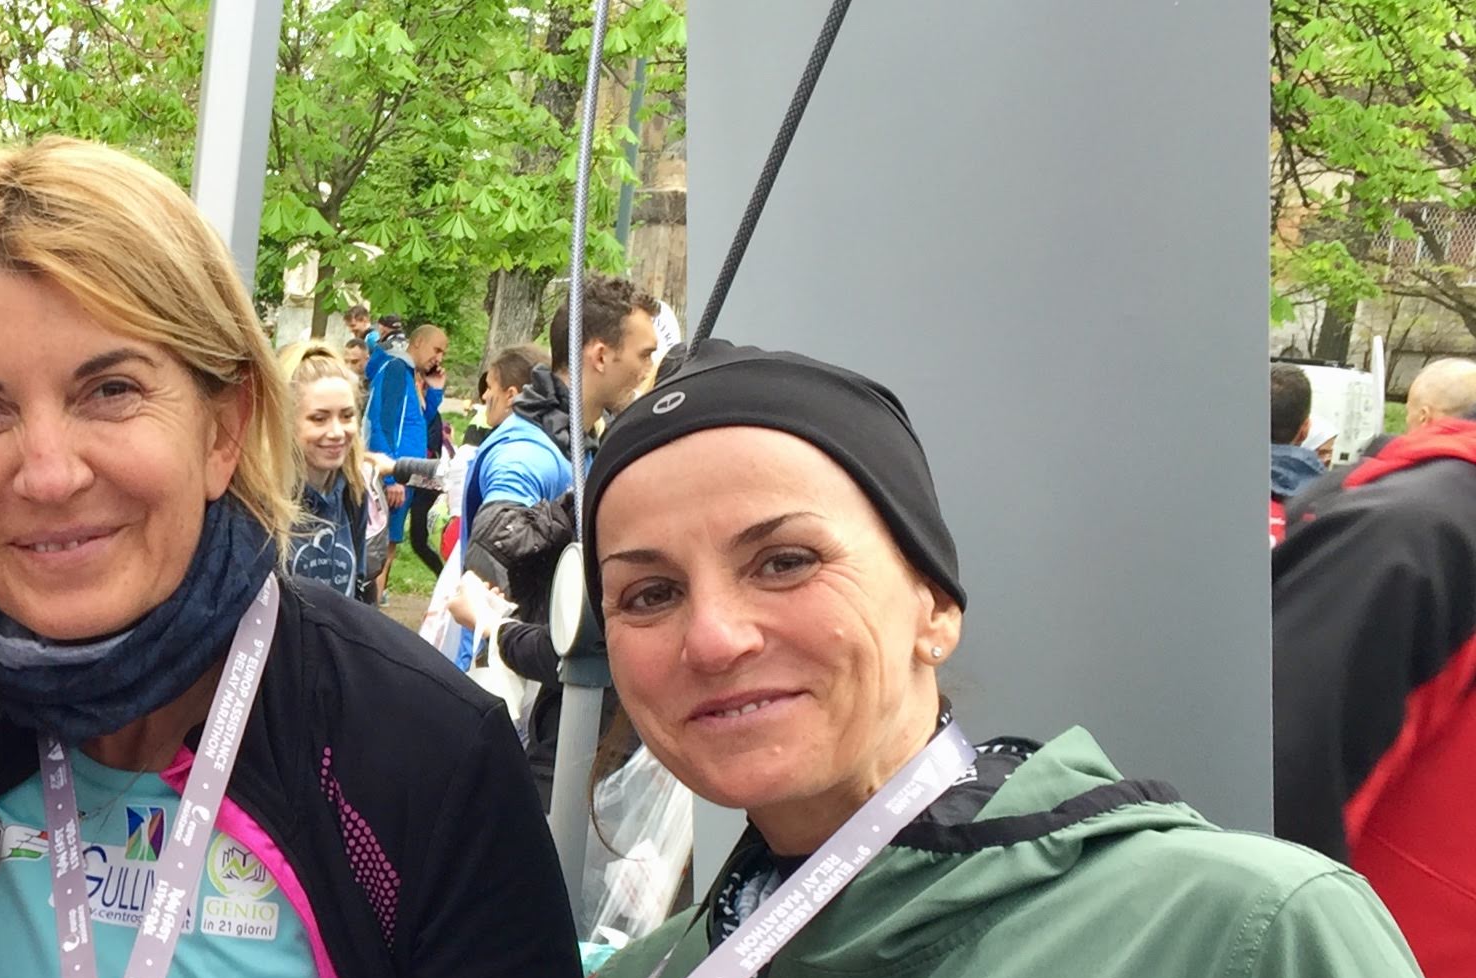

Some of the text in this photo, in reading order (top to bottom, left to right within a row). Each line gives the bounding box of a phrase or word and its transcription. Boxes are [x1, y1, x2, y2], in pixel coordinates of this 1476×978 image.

[205, 650, 248, 760] RELAY MARATHON
[239, 655, 260, 698] EUROP
[213, 698, 246, 773] ASSISTANCE
[203, 920, 273, 937] in 21 giorni
[206, 899, 275, 921] GENIO
[734, 853, 842, 957] RELAY MARATHON
[739, 844, 872, 971] 9TH EUROP ASSISTANCE
